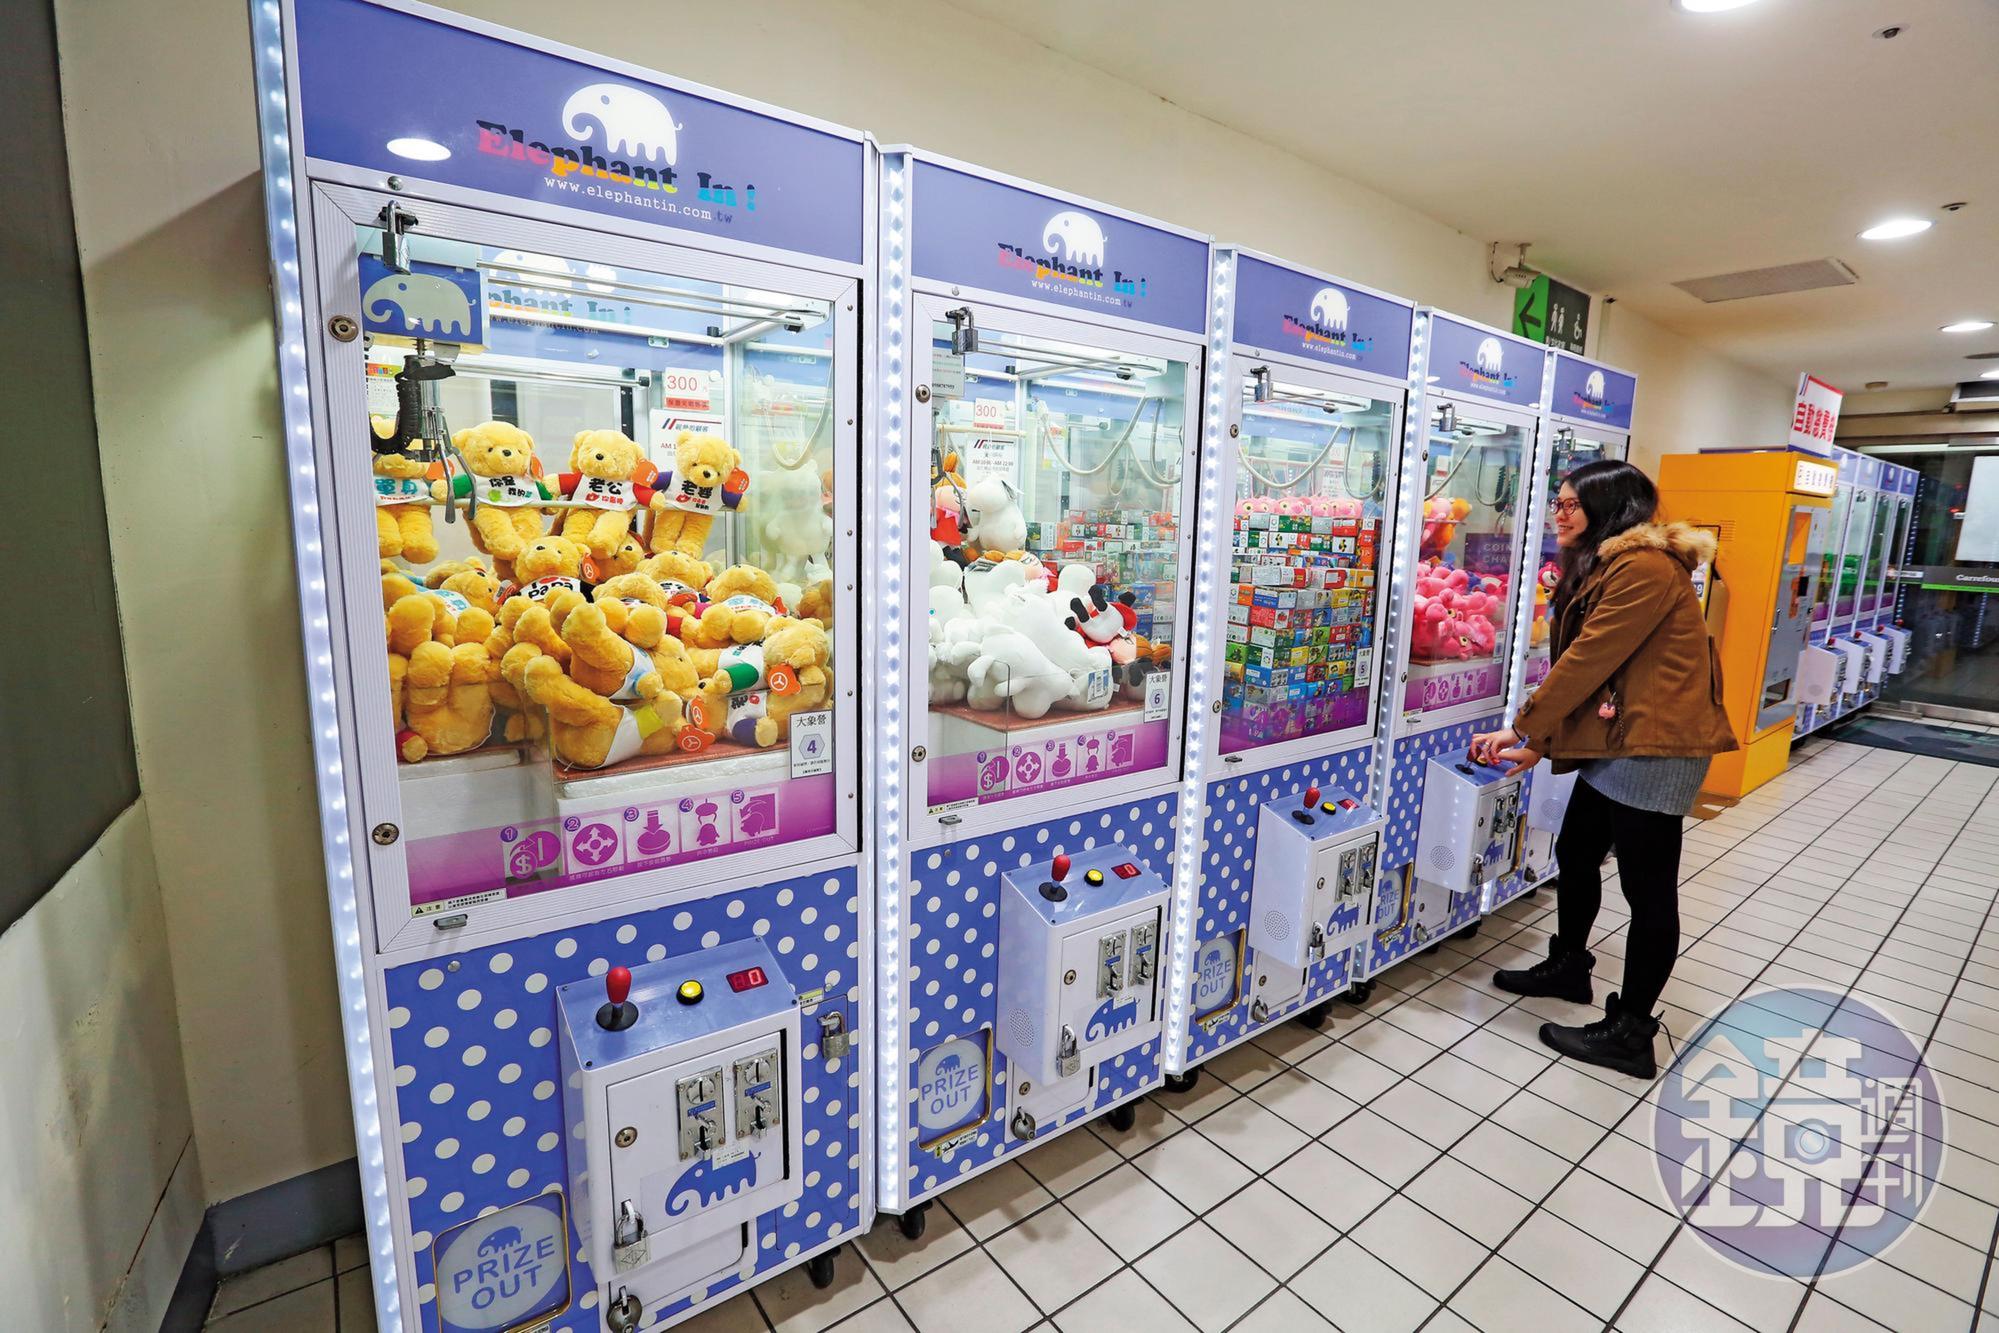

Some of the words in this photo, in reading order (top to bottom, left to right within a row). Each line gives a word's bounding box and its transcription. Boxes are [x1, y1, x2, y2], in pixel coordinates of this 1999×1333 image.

[476, 119, 678, 193] Elephant
[544, 176, 733, 224] www.elephantin.com.tw
[998, 242, 1103, 287] Elephant
[1283, 314, 1346, 346] Elephant
[667, 375, 697, 391] 300
[976, 405, 997, 418] 300
[589, 478, 623, 495] 老公
[1154, 693, 1161, 704] 6
[807, 739, 817, 754] 4
[1380, 888, 1400, 905] RIZE
[1378, 903, 1395, 919] OUT
[1200, 976, 1226, 997] OUT
[921, 1064, 978, 1100] PRIZE
[931, 1085, 971, 1115] OUT
[454, 1234, 555, 1294] PRIZE
[471, 1264, 542, 1310] OUT
